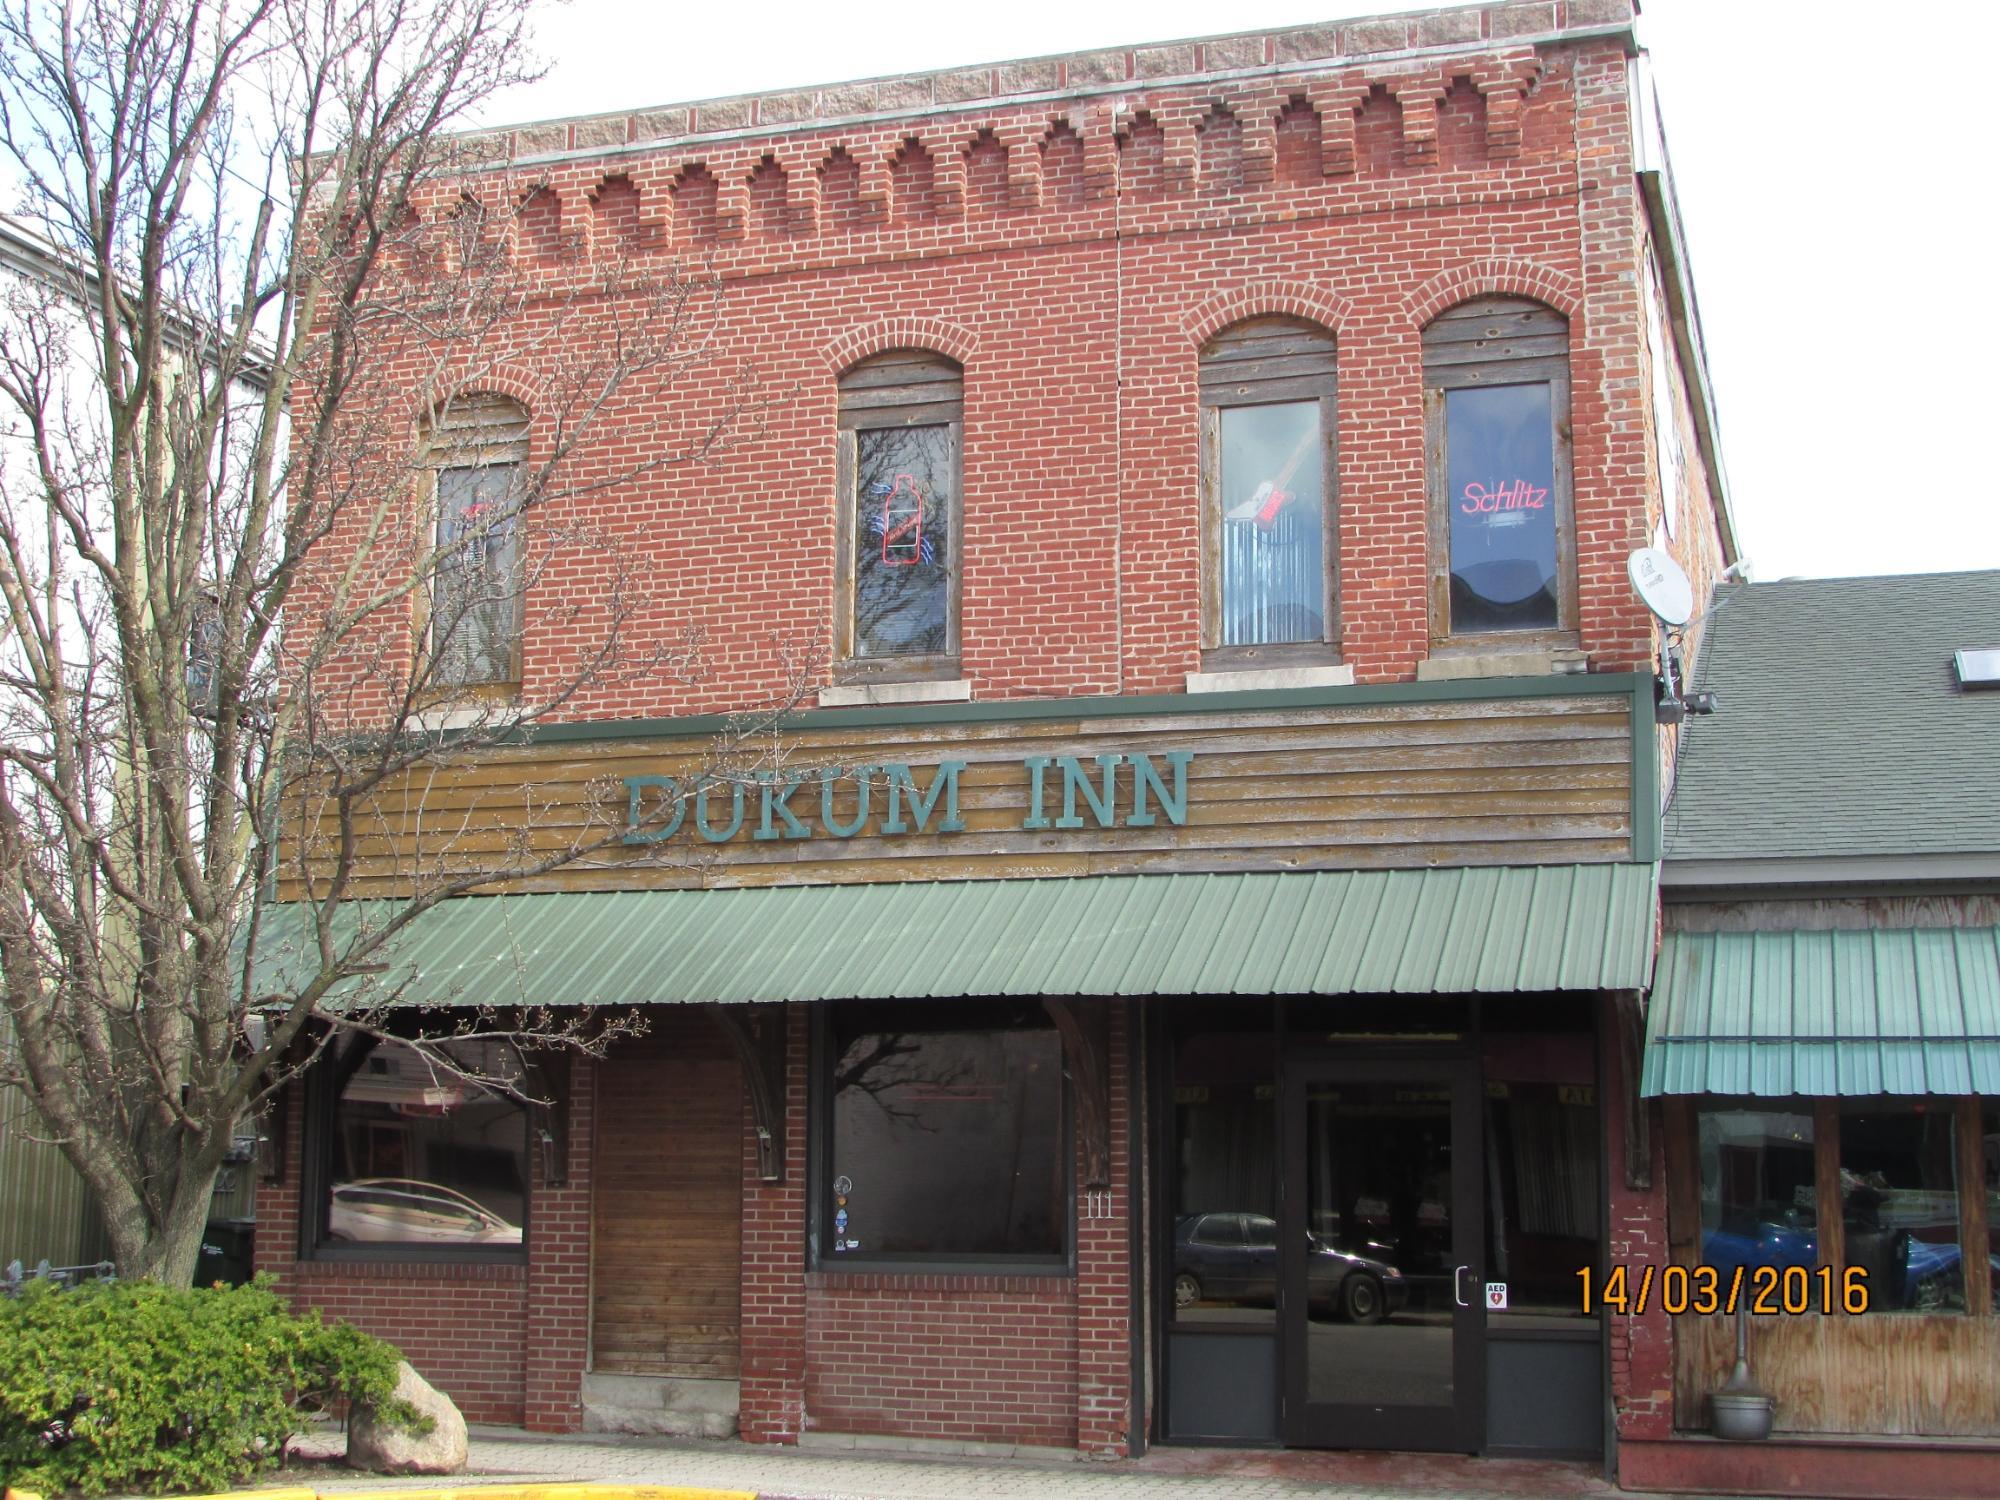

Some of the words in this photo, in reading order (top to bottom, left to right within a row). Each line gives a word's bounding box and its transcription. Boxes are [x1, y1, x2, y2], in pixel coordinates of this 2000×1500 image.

[622, 761, 966, 844] DUKUM
[1024, 752, 1194, 829] INN
[1084, 1190, 1115, 1219] 111
